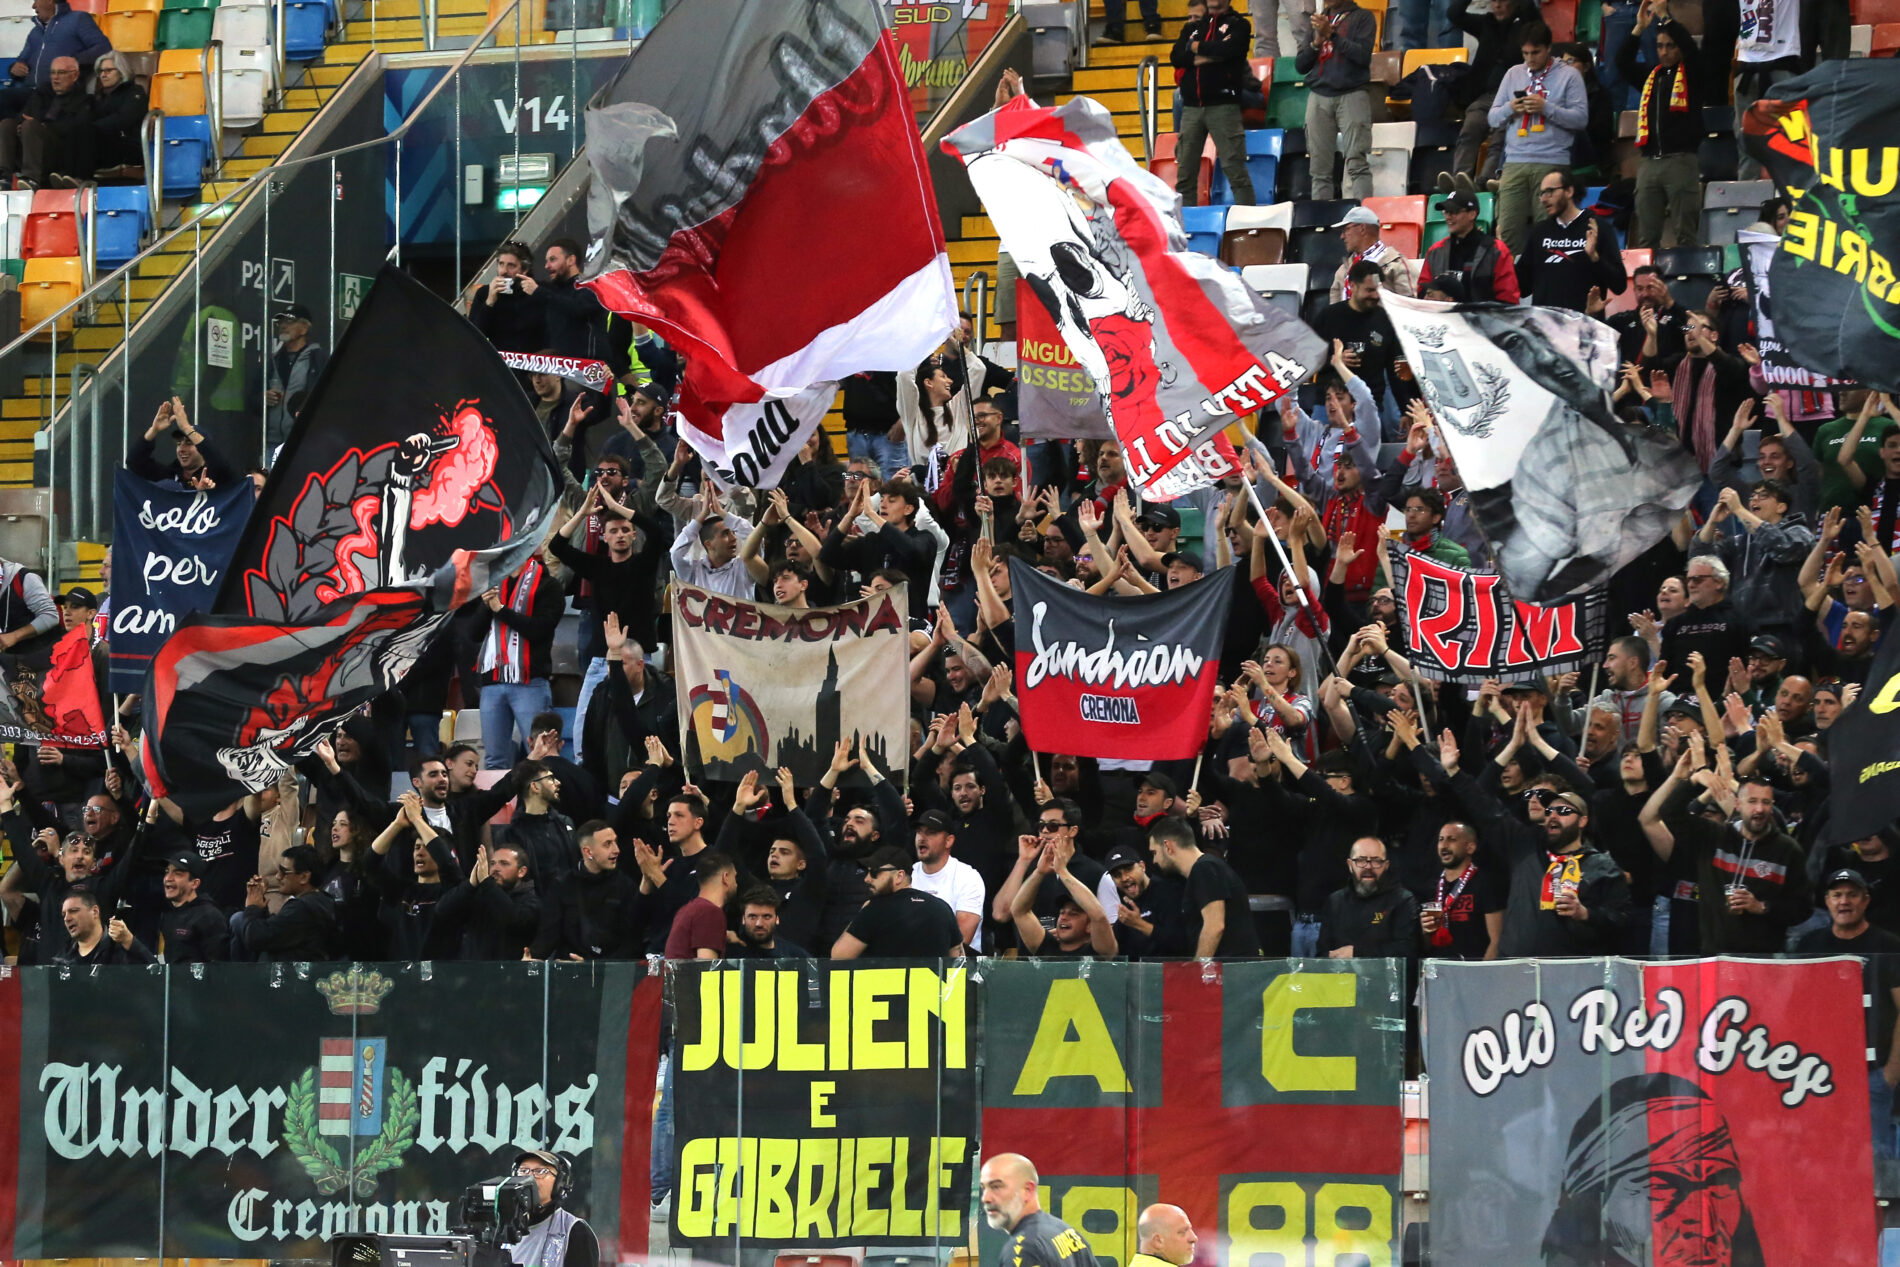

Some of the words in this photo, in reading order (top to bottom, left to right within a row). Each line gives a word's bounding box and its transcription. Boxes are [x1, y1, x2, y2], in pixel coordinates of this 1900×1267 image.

[894, 6, 952, 24] SUD
[494, 95, 569, 133] V14
[1542, 237, 1588, 249] Reebok
[242, 260, 264, 290] P2
[242, 322, 261, 351] P1
[138, 491, 221, 535] solo
[143, 551, 218, 595] per
[677, 587, 903, 643] CREMONA
[1080, 694, 1140, 724] CREMONA
[682, 967, 967, 1072] JULIEN
[1013, 979, 1133, 1095] A
[1261, 973, 1357, 1092] C
[1463, 1002, 1555, 1095] Old
[1570, 987, 1683, 1053] Red
[1699, 998, 1833, 1106] Grey
[39, 1062, 287, 1160] Under
[811, 1081, 836, 1129] E
[677, 1137, 967, 1240] GABRIELE
[228, 1188, 450, 1242] Cremona
